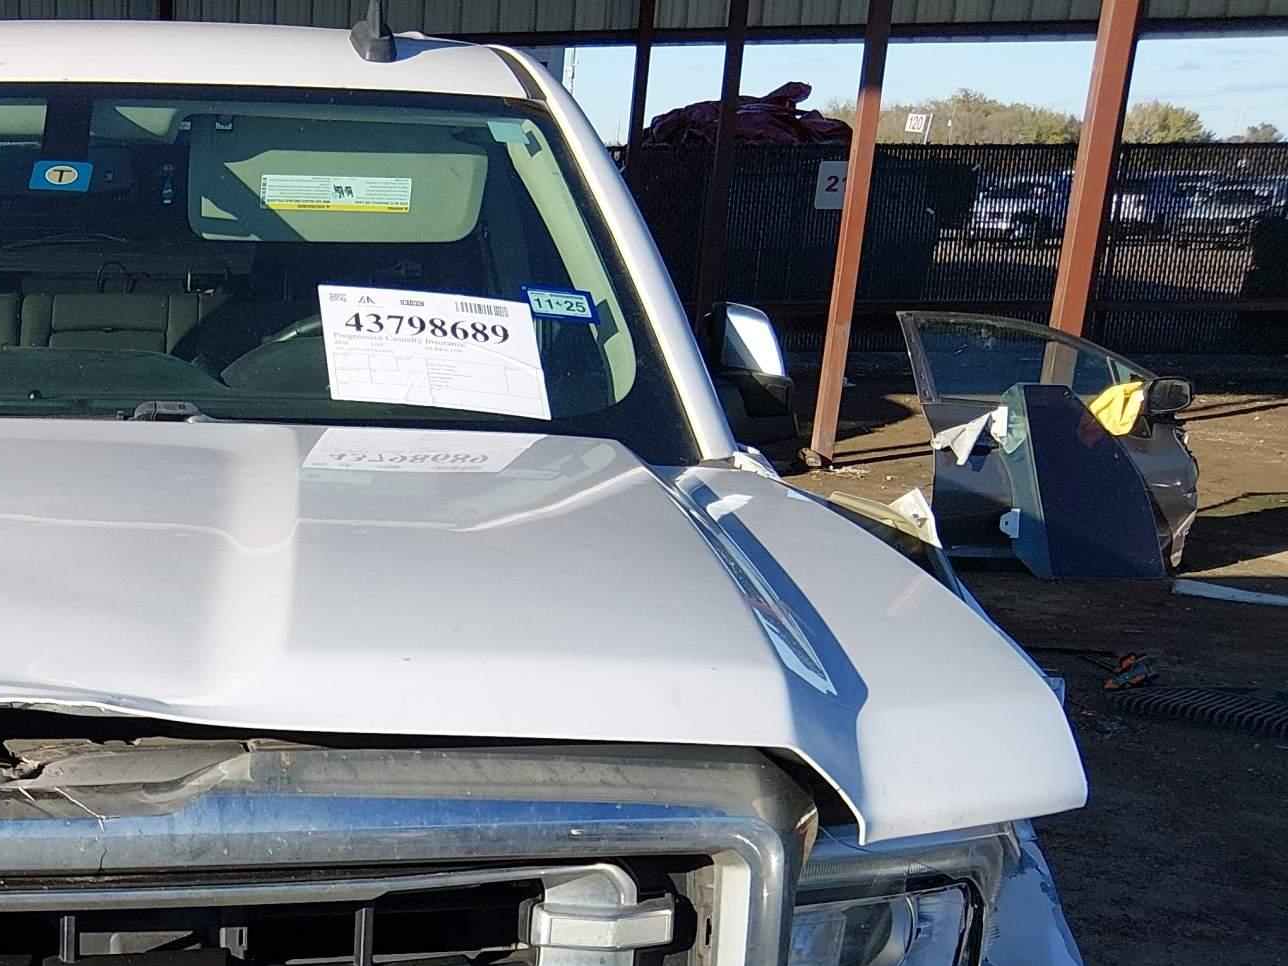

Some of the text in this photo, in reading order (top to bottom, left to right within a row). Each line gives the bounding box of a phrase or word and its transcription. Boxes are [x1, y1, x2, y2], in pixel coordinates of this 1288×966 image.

[909, 115, 924, 130] 120
[53, 169, 73, 183] T
[345, 312, 509, 344] 43798689
